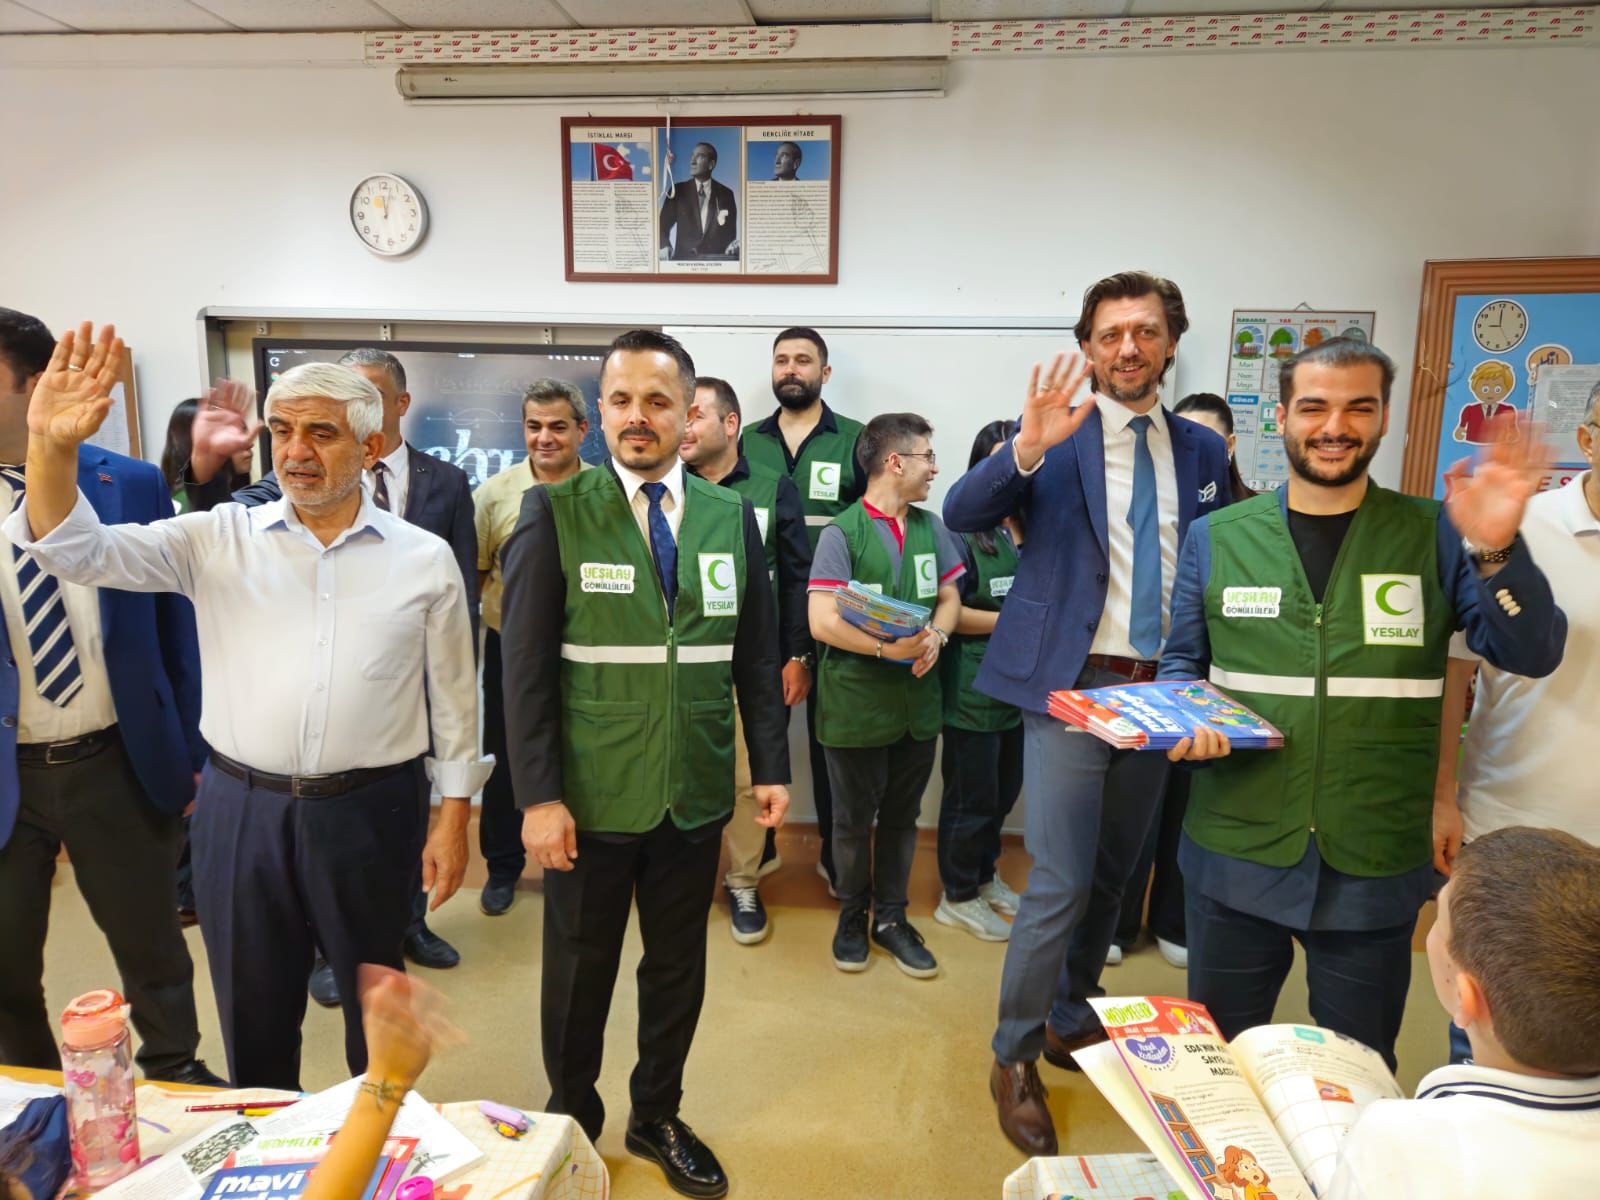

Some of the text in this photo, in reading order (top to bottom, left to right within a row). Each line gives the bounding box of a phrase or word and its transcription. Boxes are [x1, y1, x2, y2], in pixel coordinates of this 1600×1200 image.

[379, 181, 388, 190] 12
[403, 194, 411, 203] 2
[357, 211, 365, 220] 9
[410, 208, 417, 217] 3
[373, 234, 380, 243] 7
[706, 600, 735, 611] YEŞİLAY
[1371, 626, 1420, 639] YEŞİLAY
[214, 1169, 306, 1194] mavi
